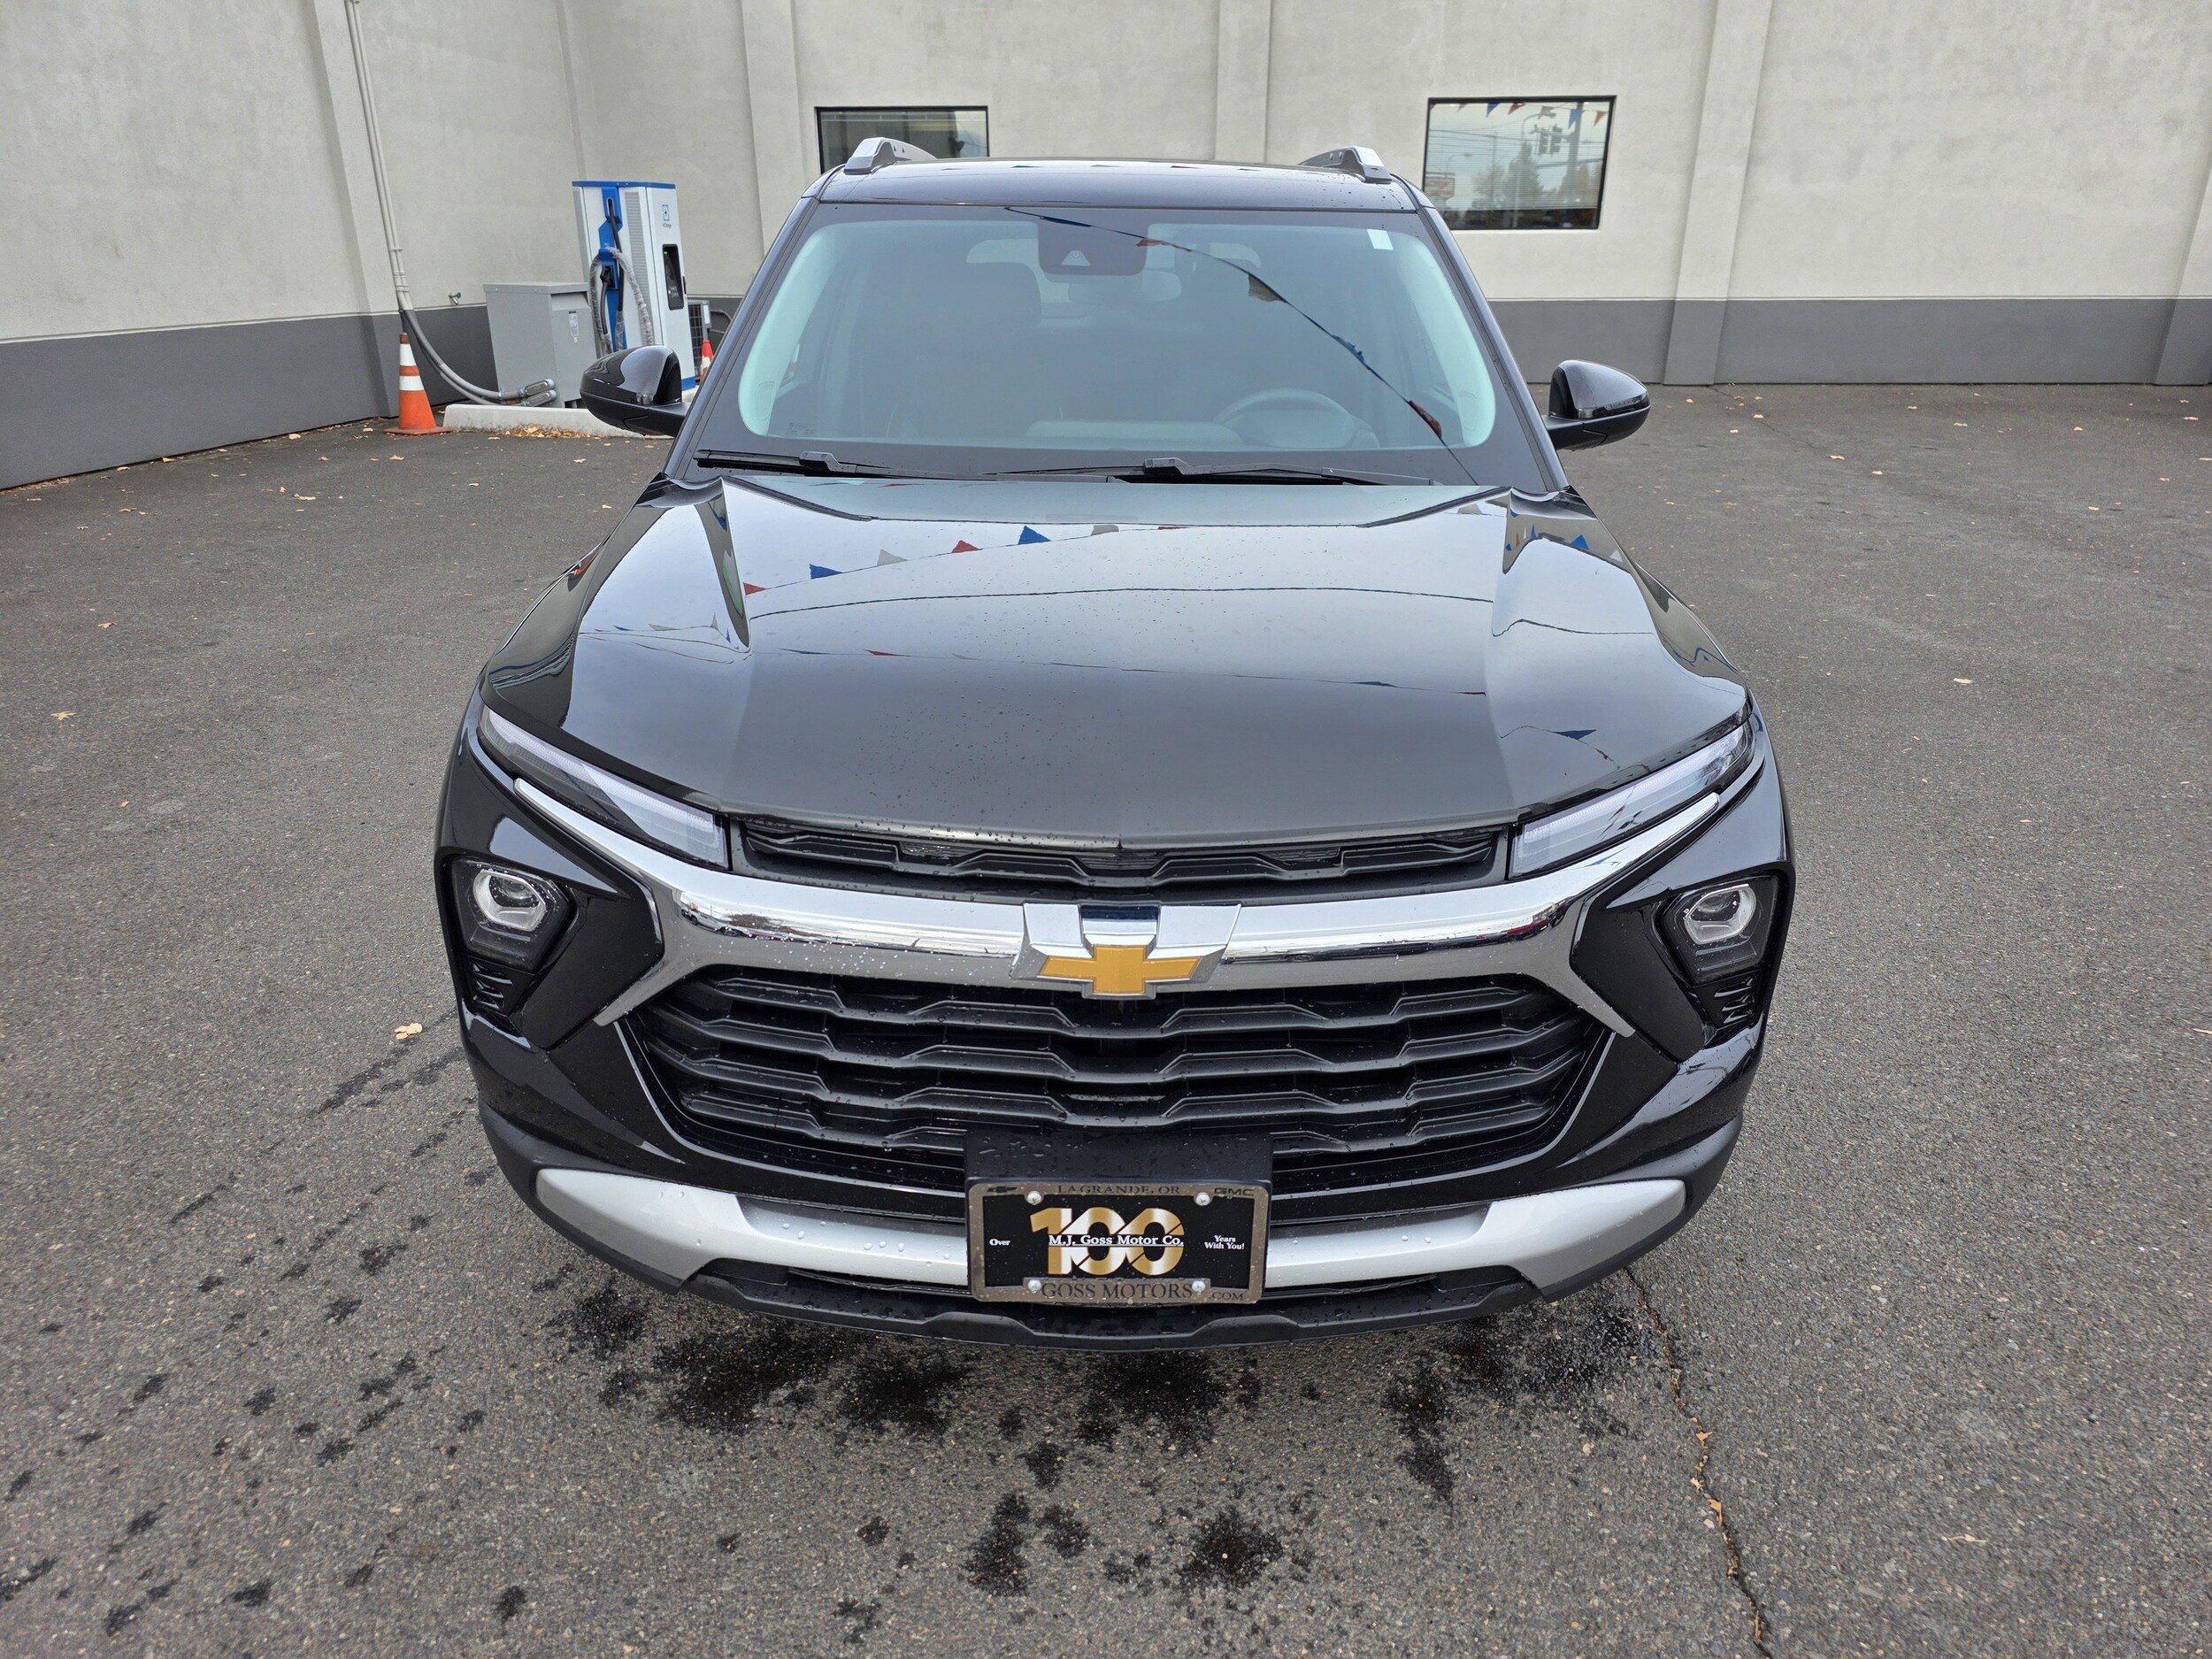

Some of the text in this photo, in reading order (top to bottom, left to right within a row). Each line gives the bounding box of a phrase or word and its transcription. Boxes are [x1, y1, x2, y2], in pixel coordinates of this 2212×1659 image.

[1158, 1186, 1180, 1194] OR
[1214, 1187, 1255, 1196] GMC
[1029, 1206, 1185, 1276] 100
[1048, 1234, 1185, 1247] M.J. Goss Motor Co.
[1041, 1283, 1095, 1300] GOSS
[1102, 1283, 1193, 1300] MOTORS
